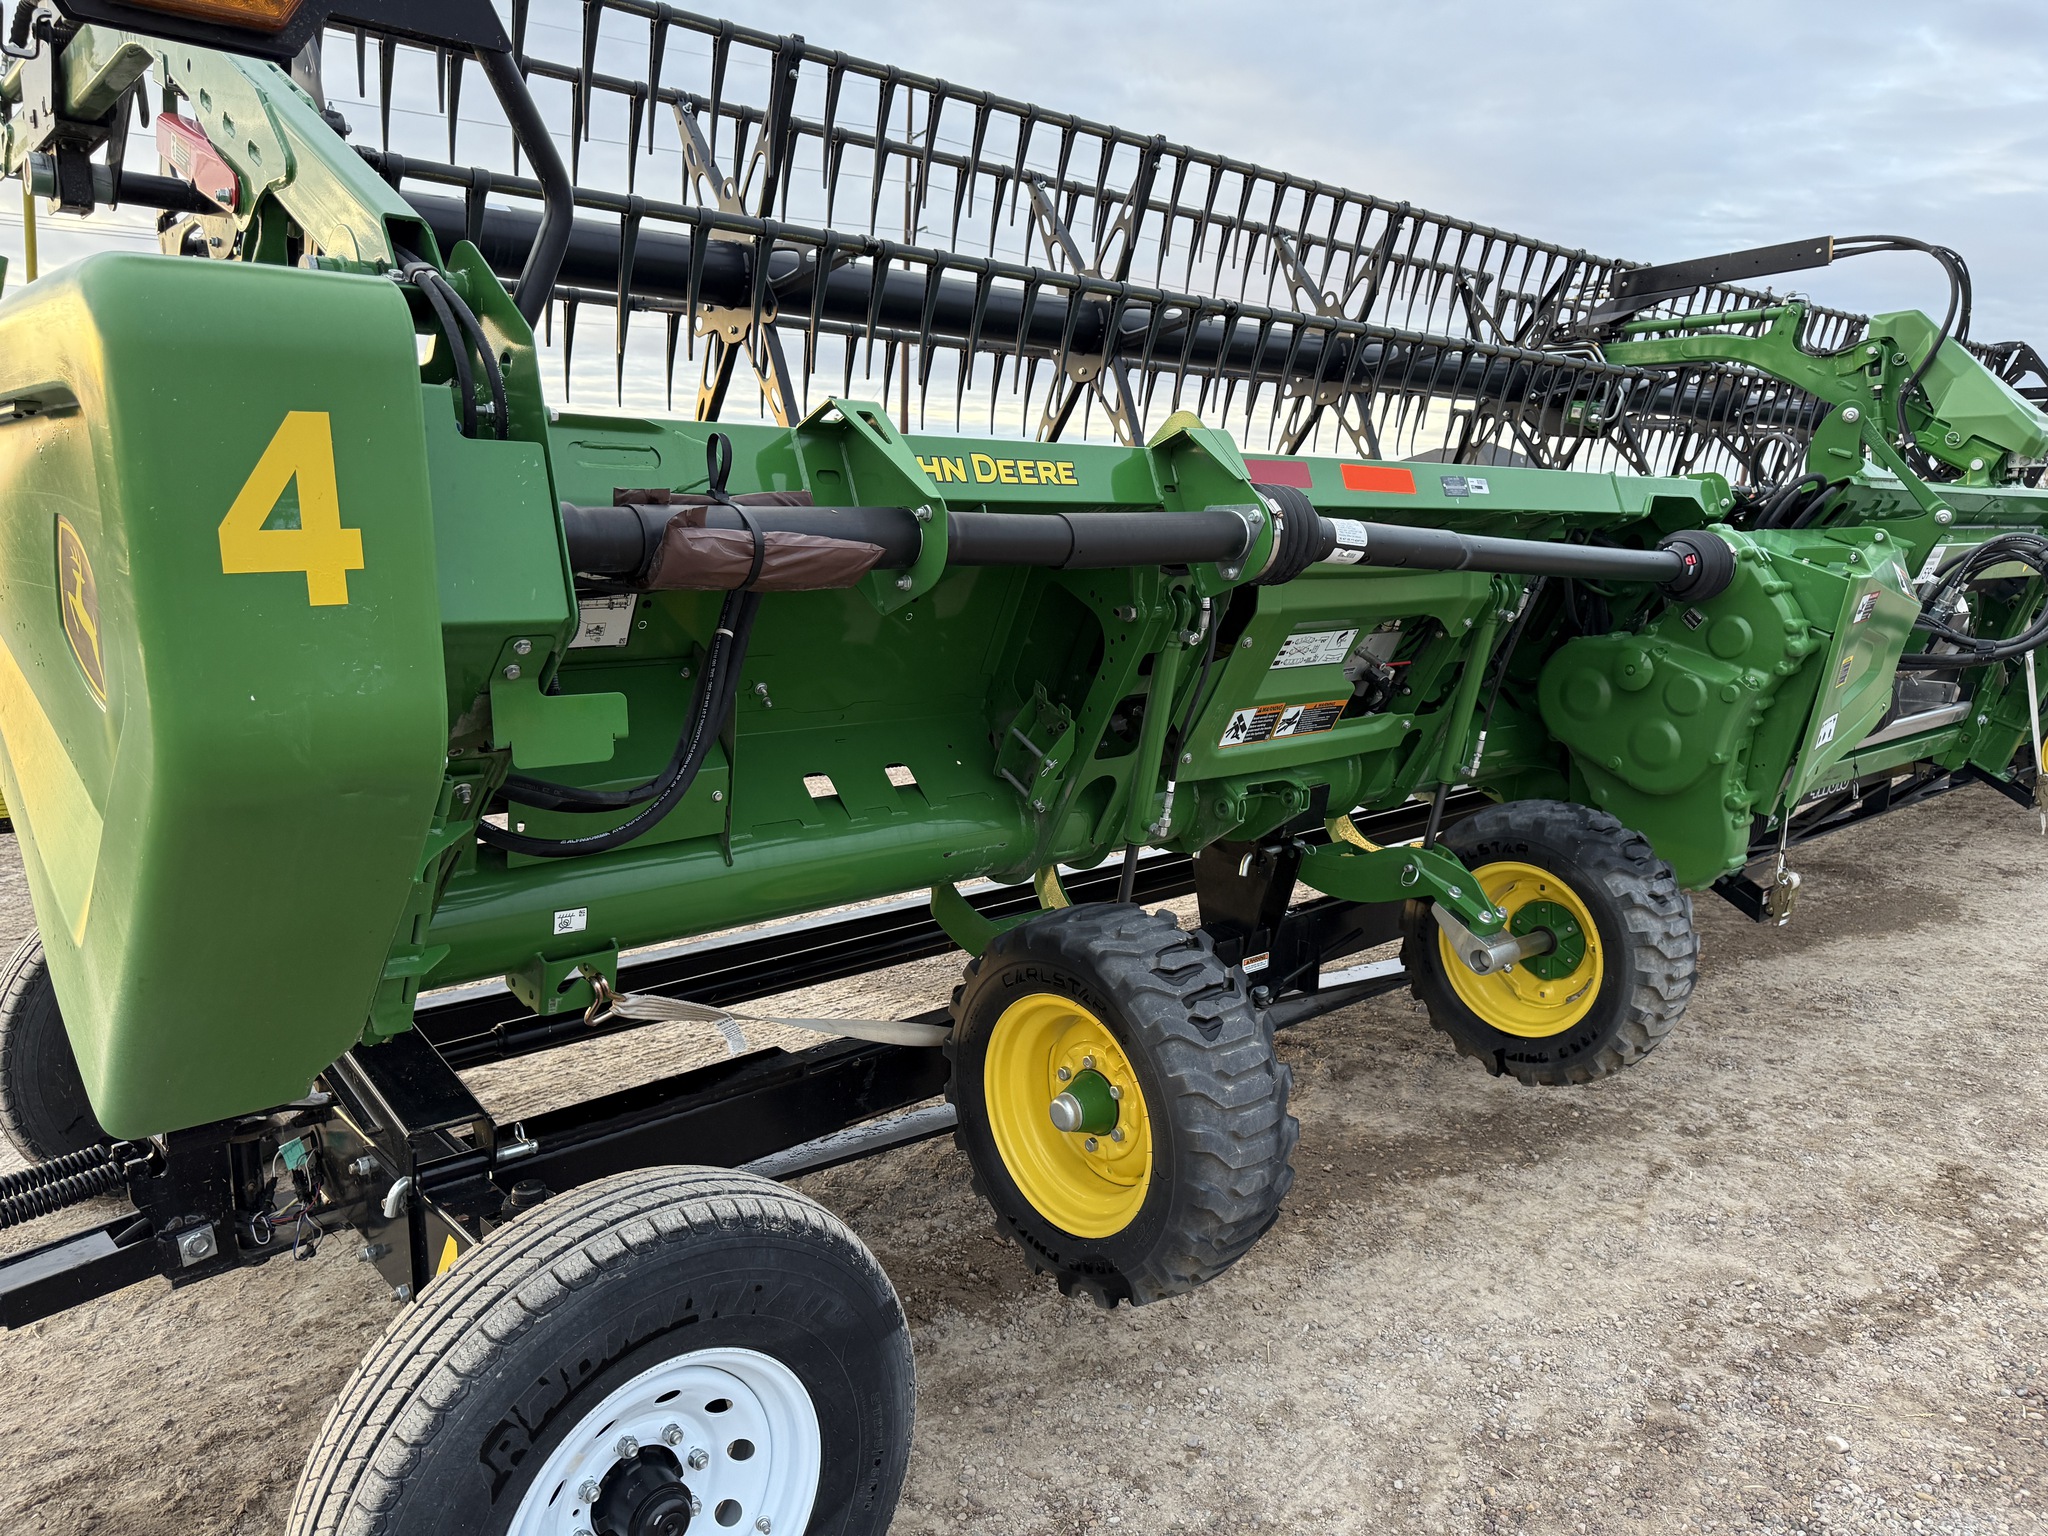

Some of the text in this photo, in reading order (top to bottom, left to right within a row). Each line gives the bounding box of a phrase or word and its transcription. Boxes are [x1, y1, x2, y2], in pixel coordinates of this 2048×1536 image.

[969, 452, 1079, 486] DEERE
[218, 411, 364, 608] 4
[1002, 968, 1107, 1015] CARLSTAR
